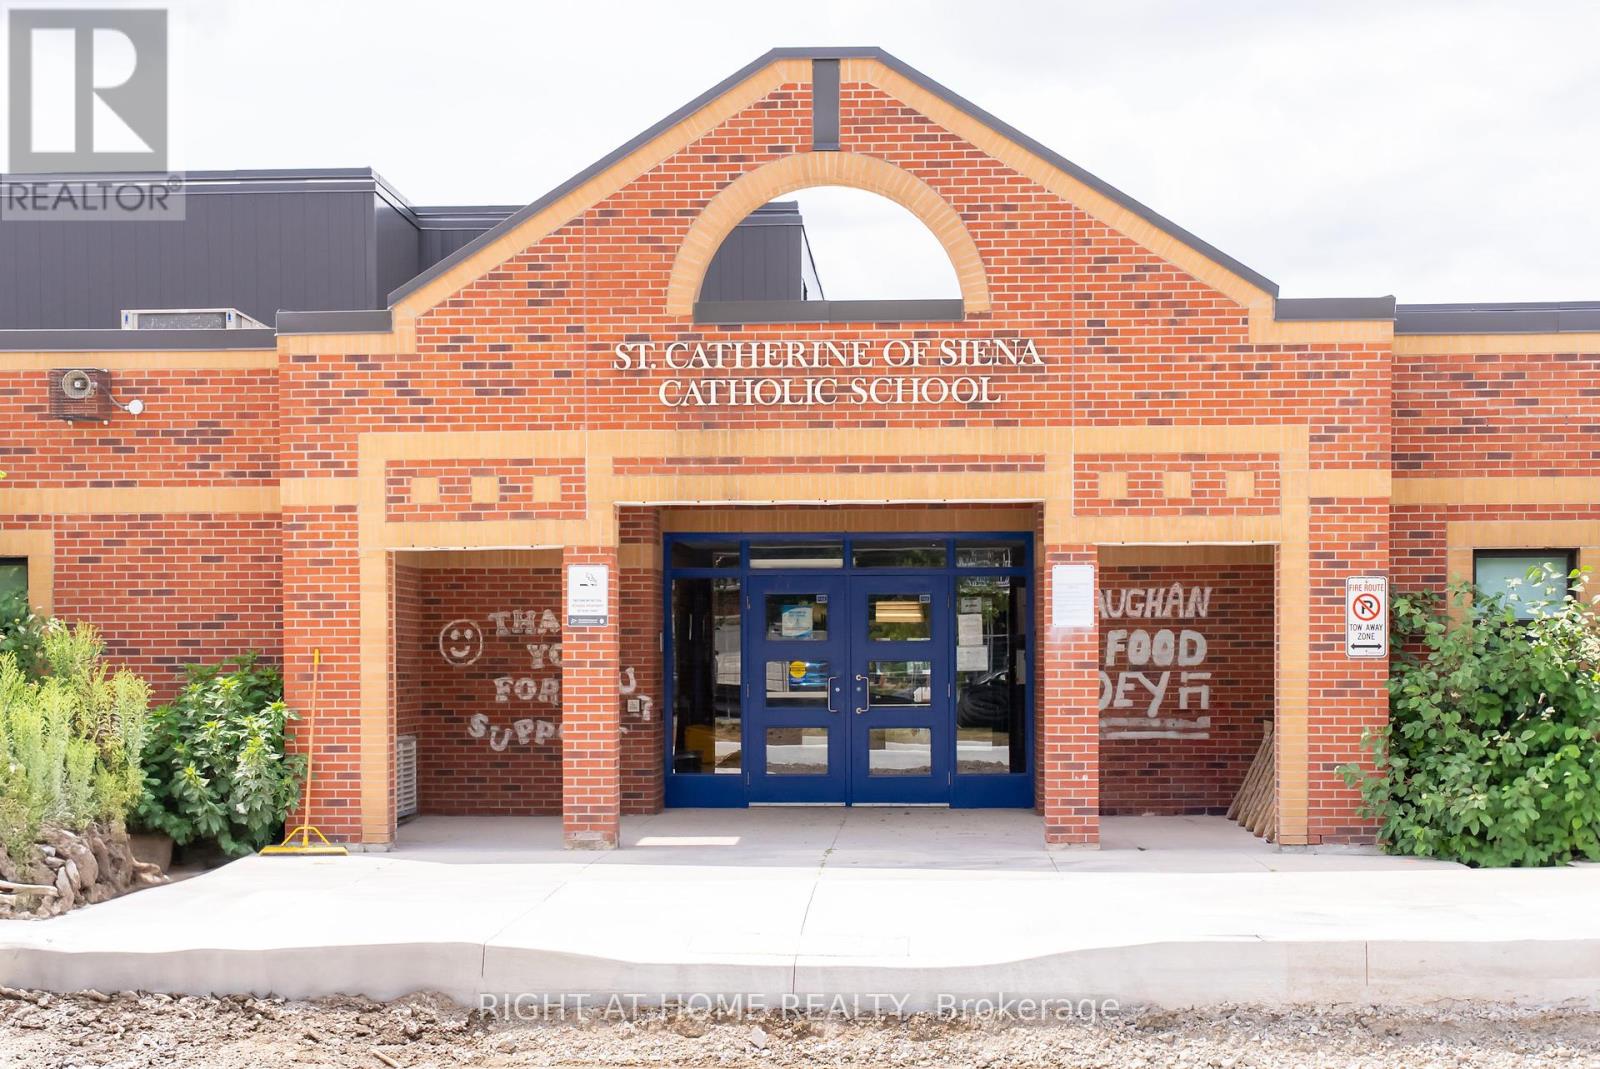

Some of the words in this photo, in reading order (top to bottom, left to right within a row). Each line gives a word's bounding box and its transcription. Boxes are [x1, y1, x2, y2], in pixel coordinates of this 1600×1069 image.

[613, 342, 657, 370] ST.
[665, 341, 873, 369] CATHERINE
[882, 340, 931, 368] OF
[939, 338, 1045, 367] SIENA
[658, 377, 838, 407] CATHOLIC
[850, 376, 1001, 405] SCHOOL
[1349, 583, 1362, 592] FIRE
[1364, 583, 1385, 592] ROUTE
[487, 608, 561, 637] THA
[1349, 623, 1363, 631] TOW
[1366, 623, 1383, 631] AWAY
[1357, 632, 1376, 640] ZONE
[1105, 628, 1208, 667] FOOD
[493, 676, 561, 707] FOR
[467, 712, 563, 752] SUPP
